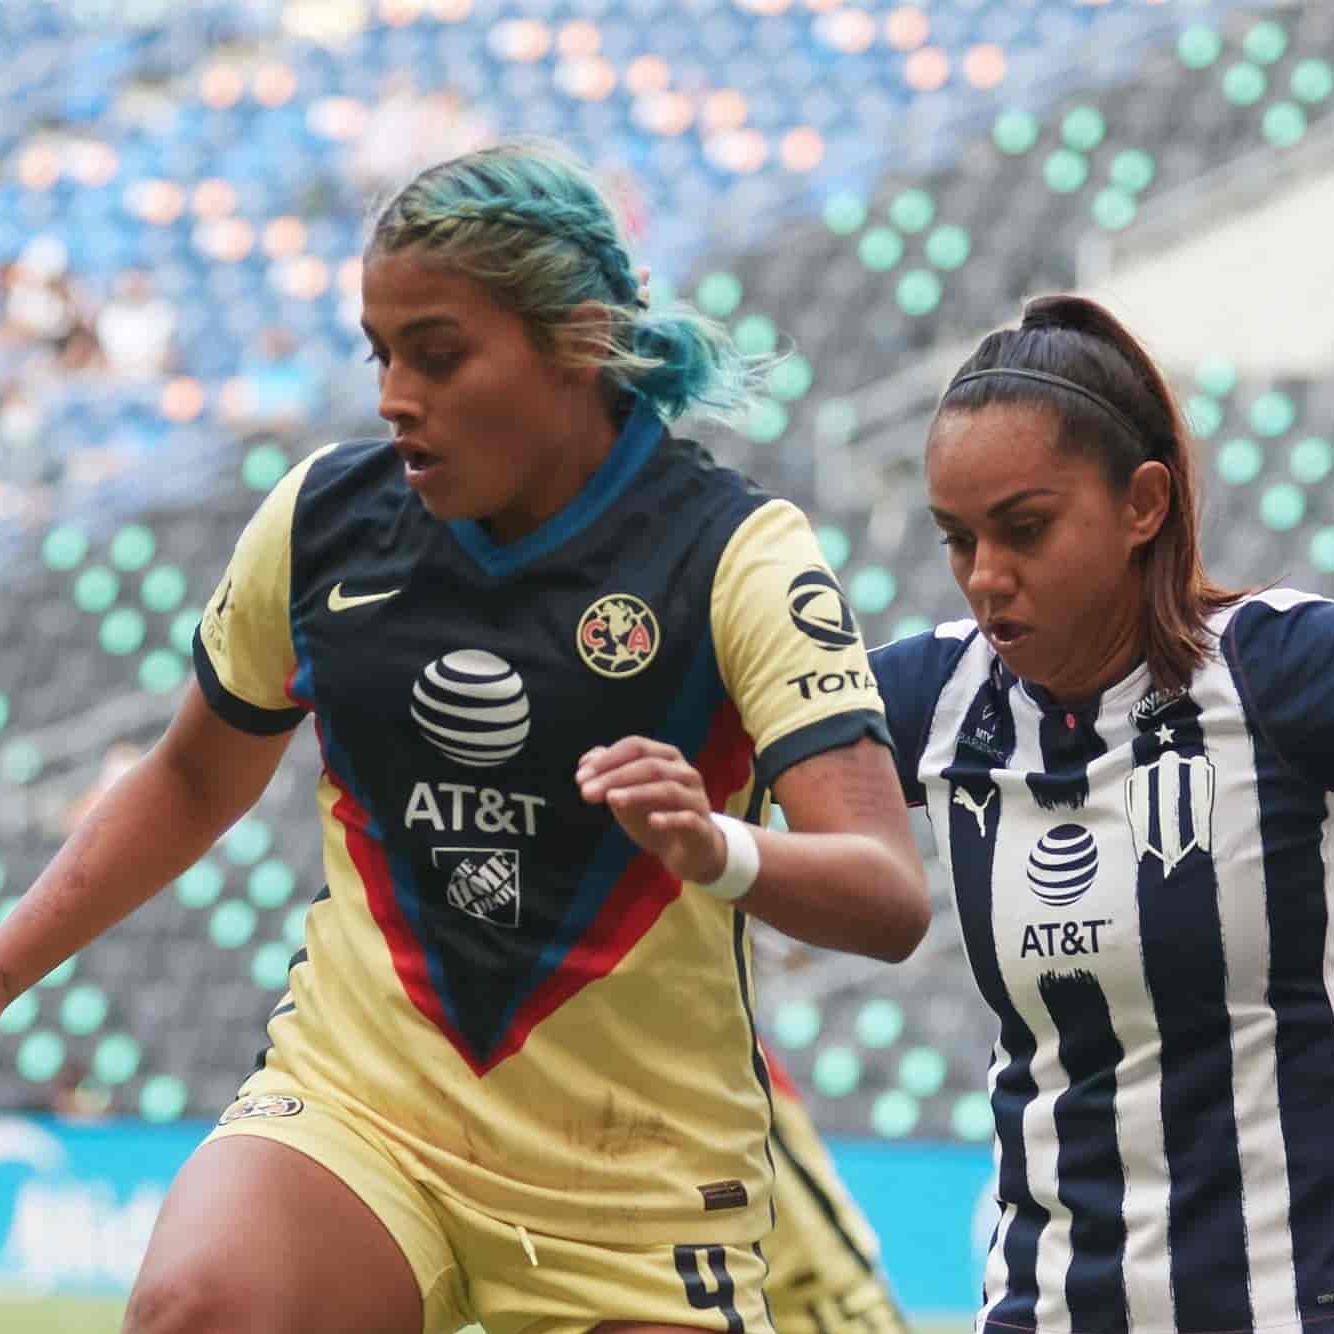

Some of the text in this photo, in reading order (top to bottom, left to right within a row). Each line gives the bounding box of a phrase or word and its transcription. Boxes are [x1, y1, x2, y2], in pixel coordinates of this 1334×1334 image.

[786, 669, 876, 700] TOTA
[404, 781, 547, 836] AT&T
[1020, 919, 1110, 959] AT&T
